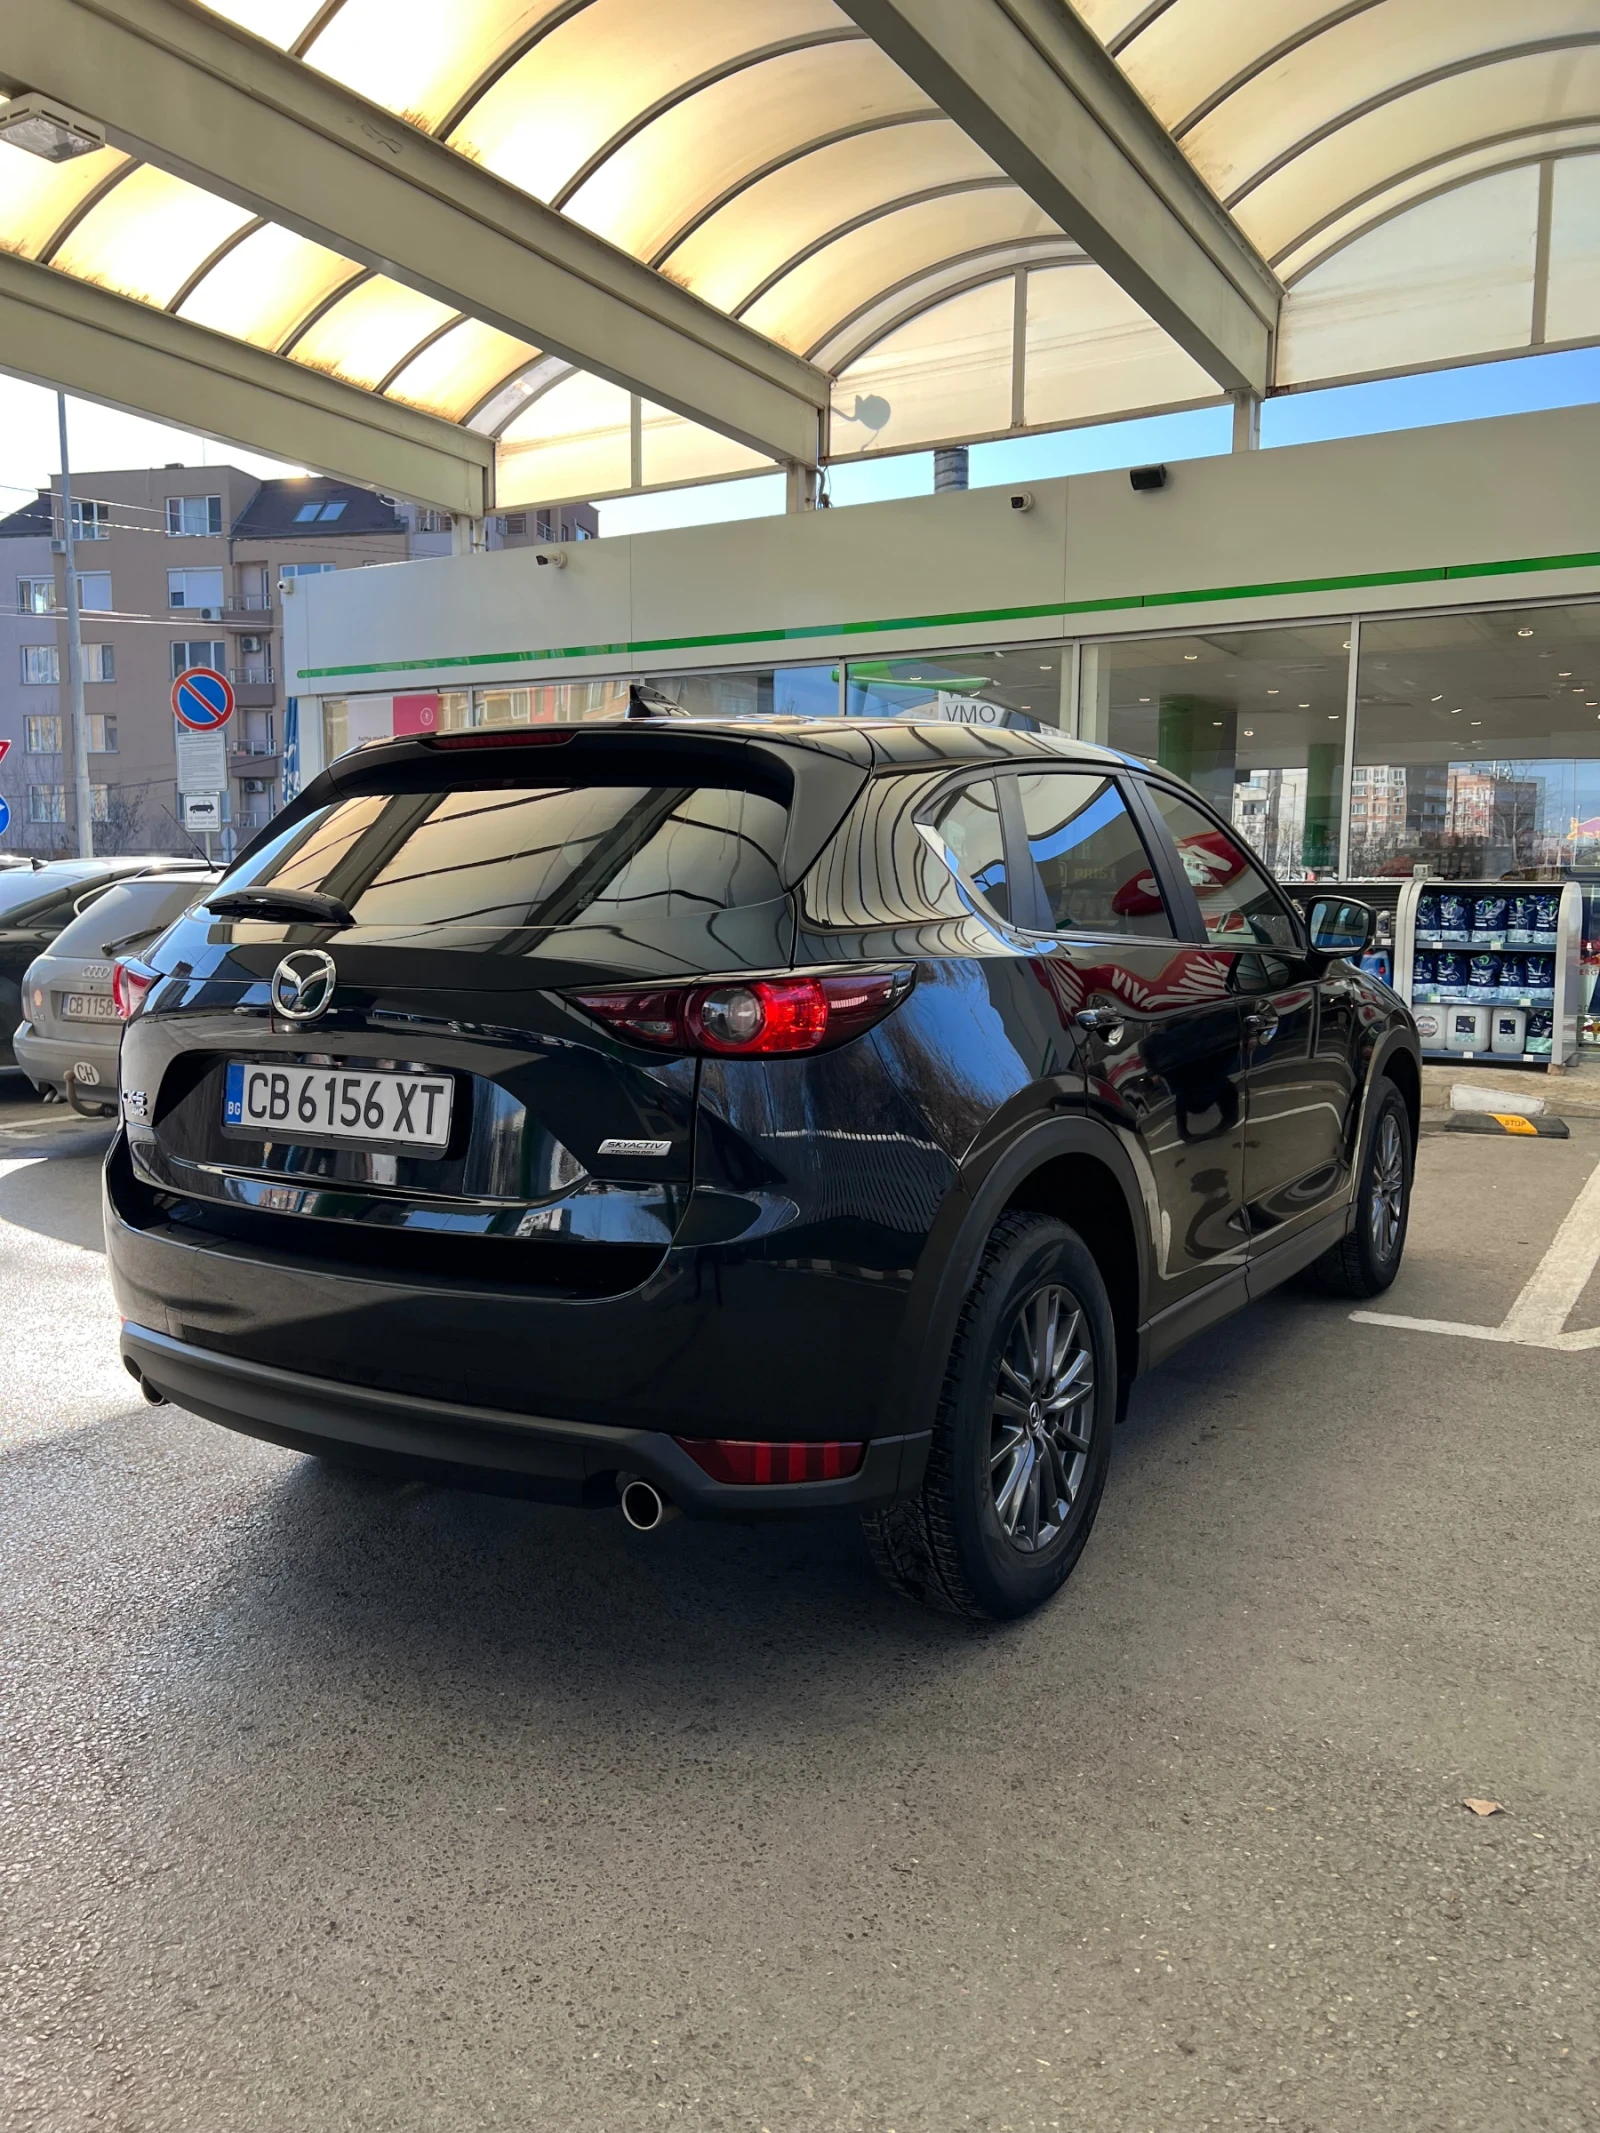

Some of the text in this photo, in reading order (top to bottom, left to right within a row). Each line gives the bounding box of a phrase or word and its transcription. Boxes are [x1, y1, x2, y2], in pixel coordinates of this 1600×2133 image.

[69, 996, 113, 1016] CB 1158
[77, 1064, 96, 1083] CH
[227, 1101, 241, 1116] BG
[248, 1072, 444, 1134] CB 6156 XT
[606, 1141, 664, 1149] SKYACTIV
